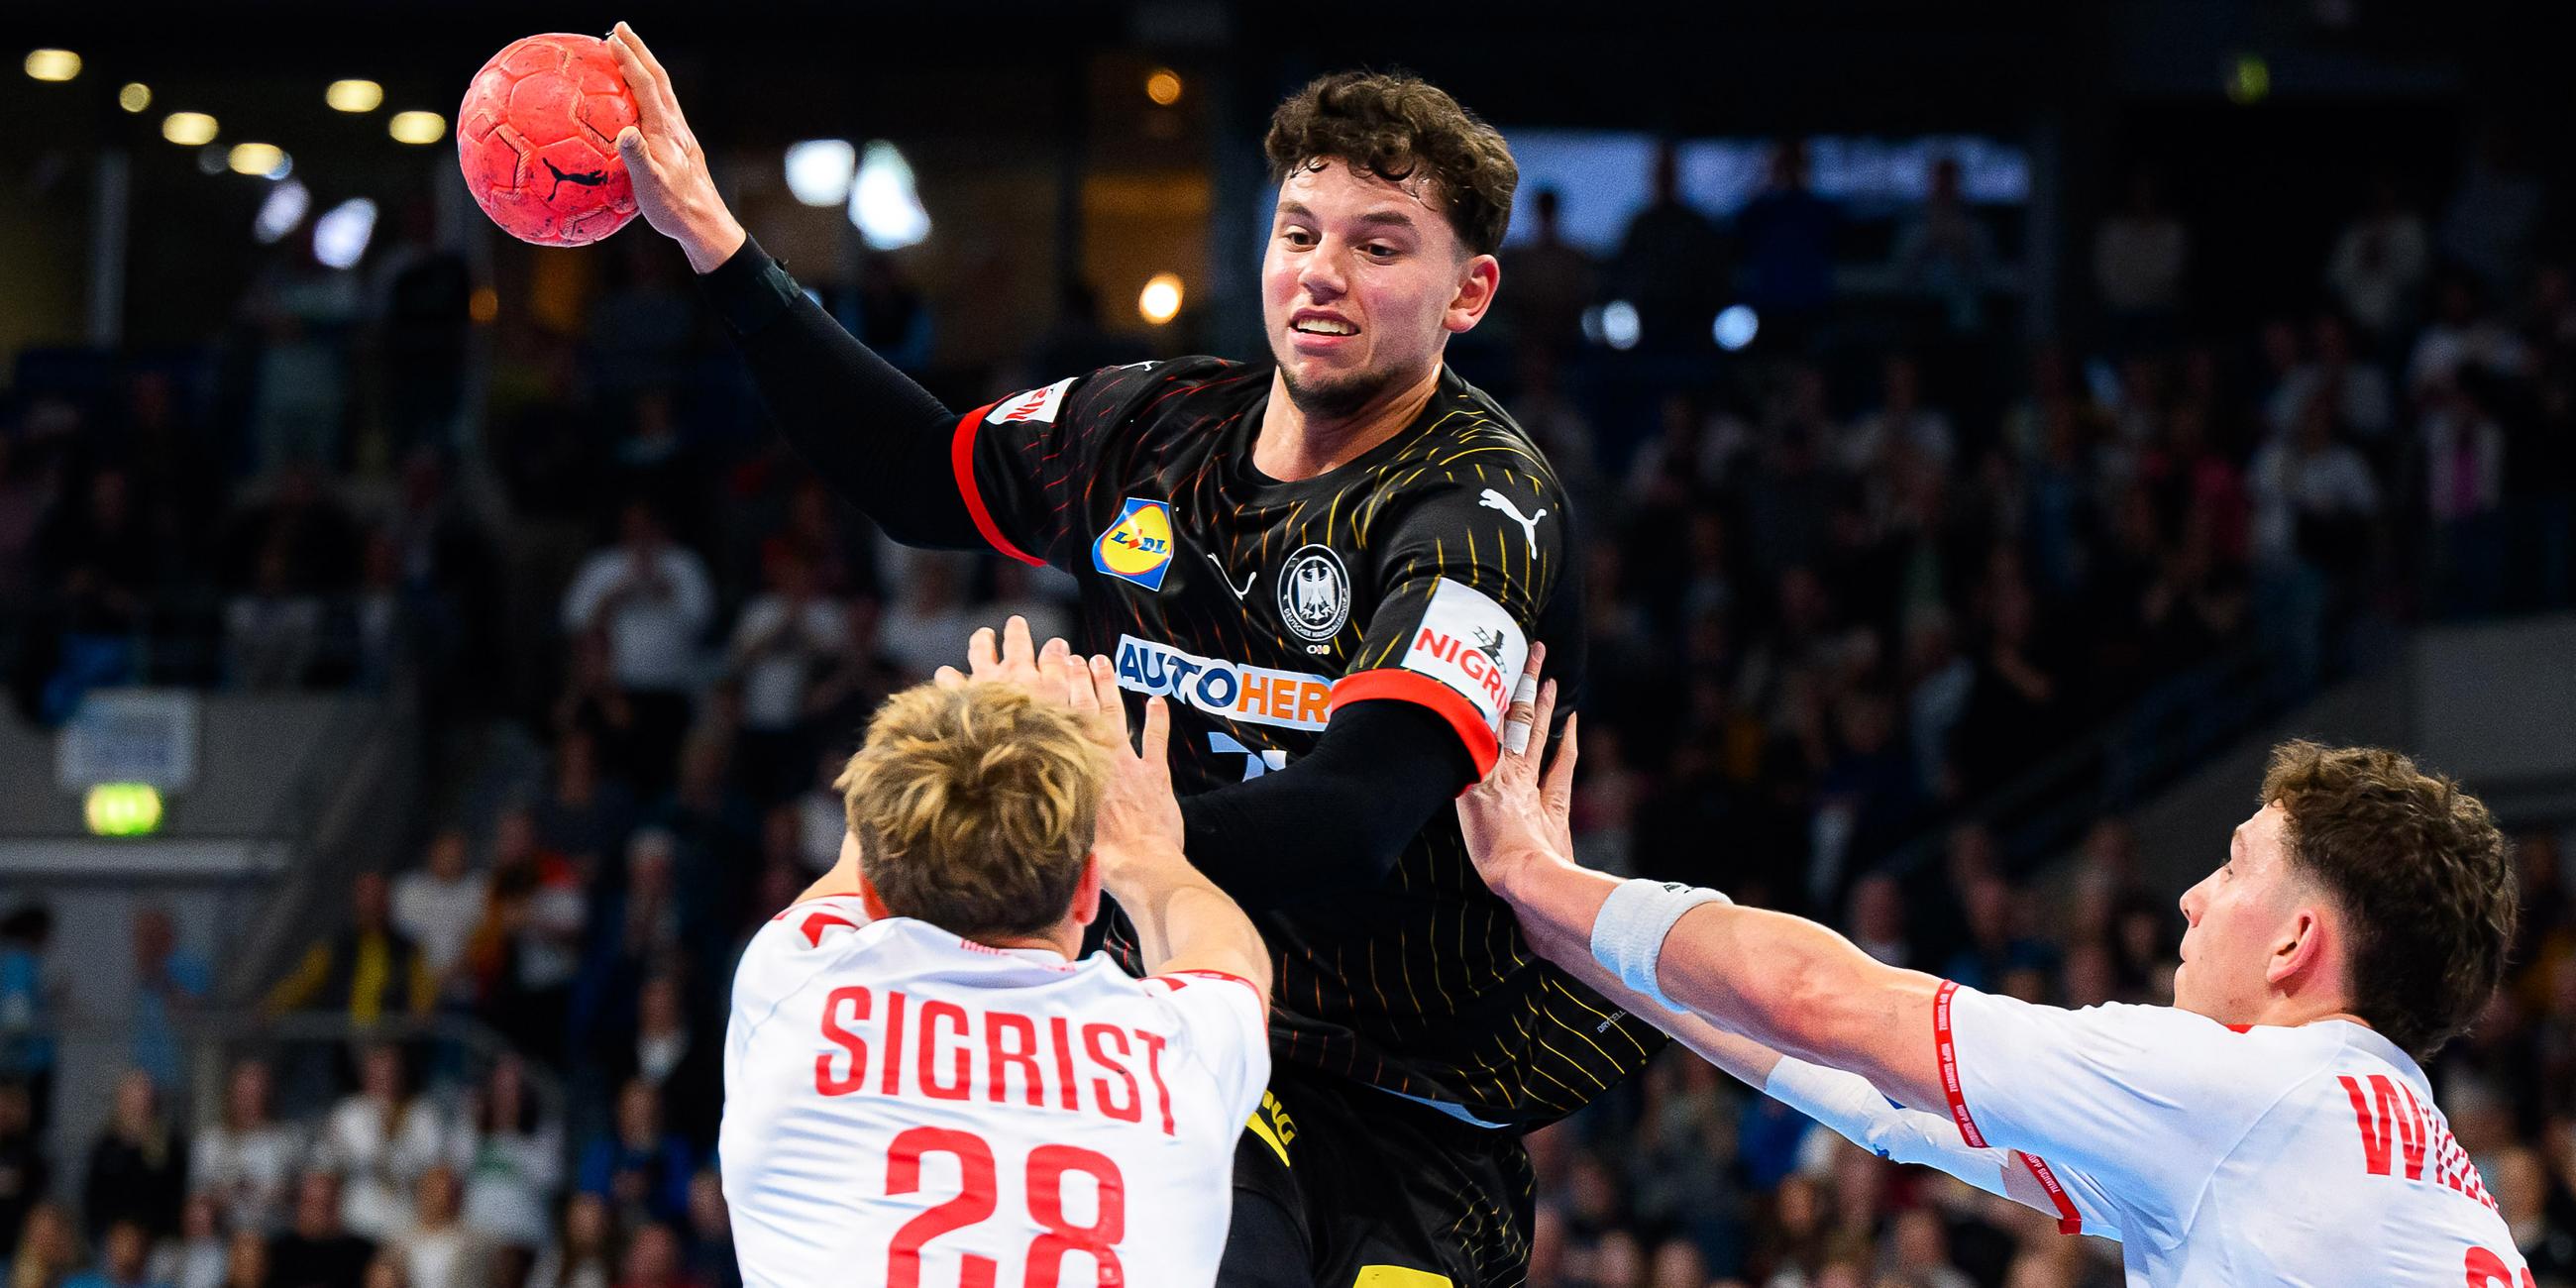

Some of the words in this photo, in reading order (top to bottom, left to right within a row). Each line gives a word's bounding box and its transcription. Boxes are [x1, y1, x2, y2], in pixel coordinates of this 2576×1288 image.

[1111, 529, 1167, 554] LIDL
[1415, 627, 1509, 711] NIGRI
[814, 986, 1175, 1136] SIGRIST
[885, 1126, 1126, 1288] 28
